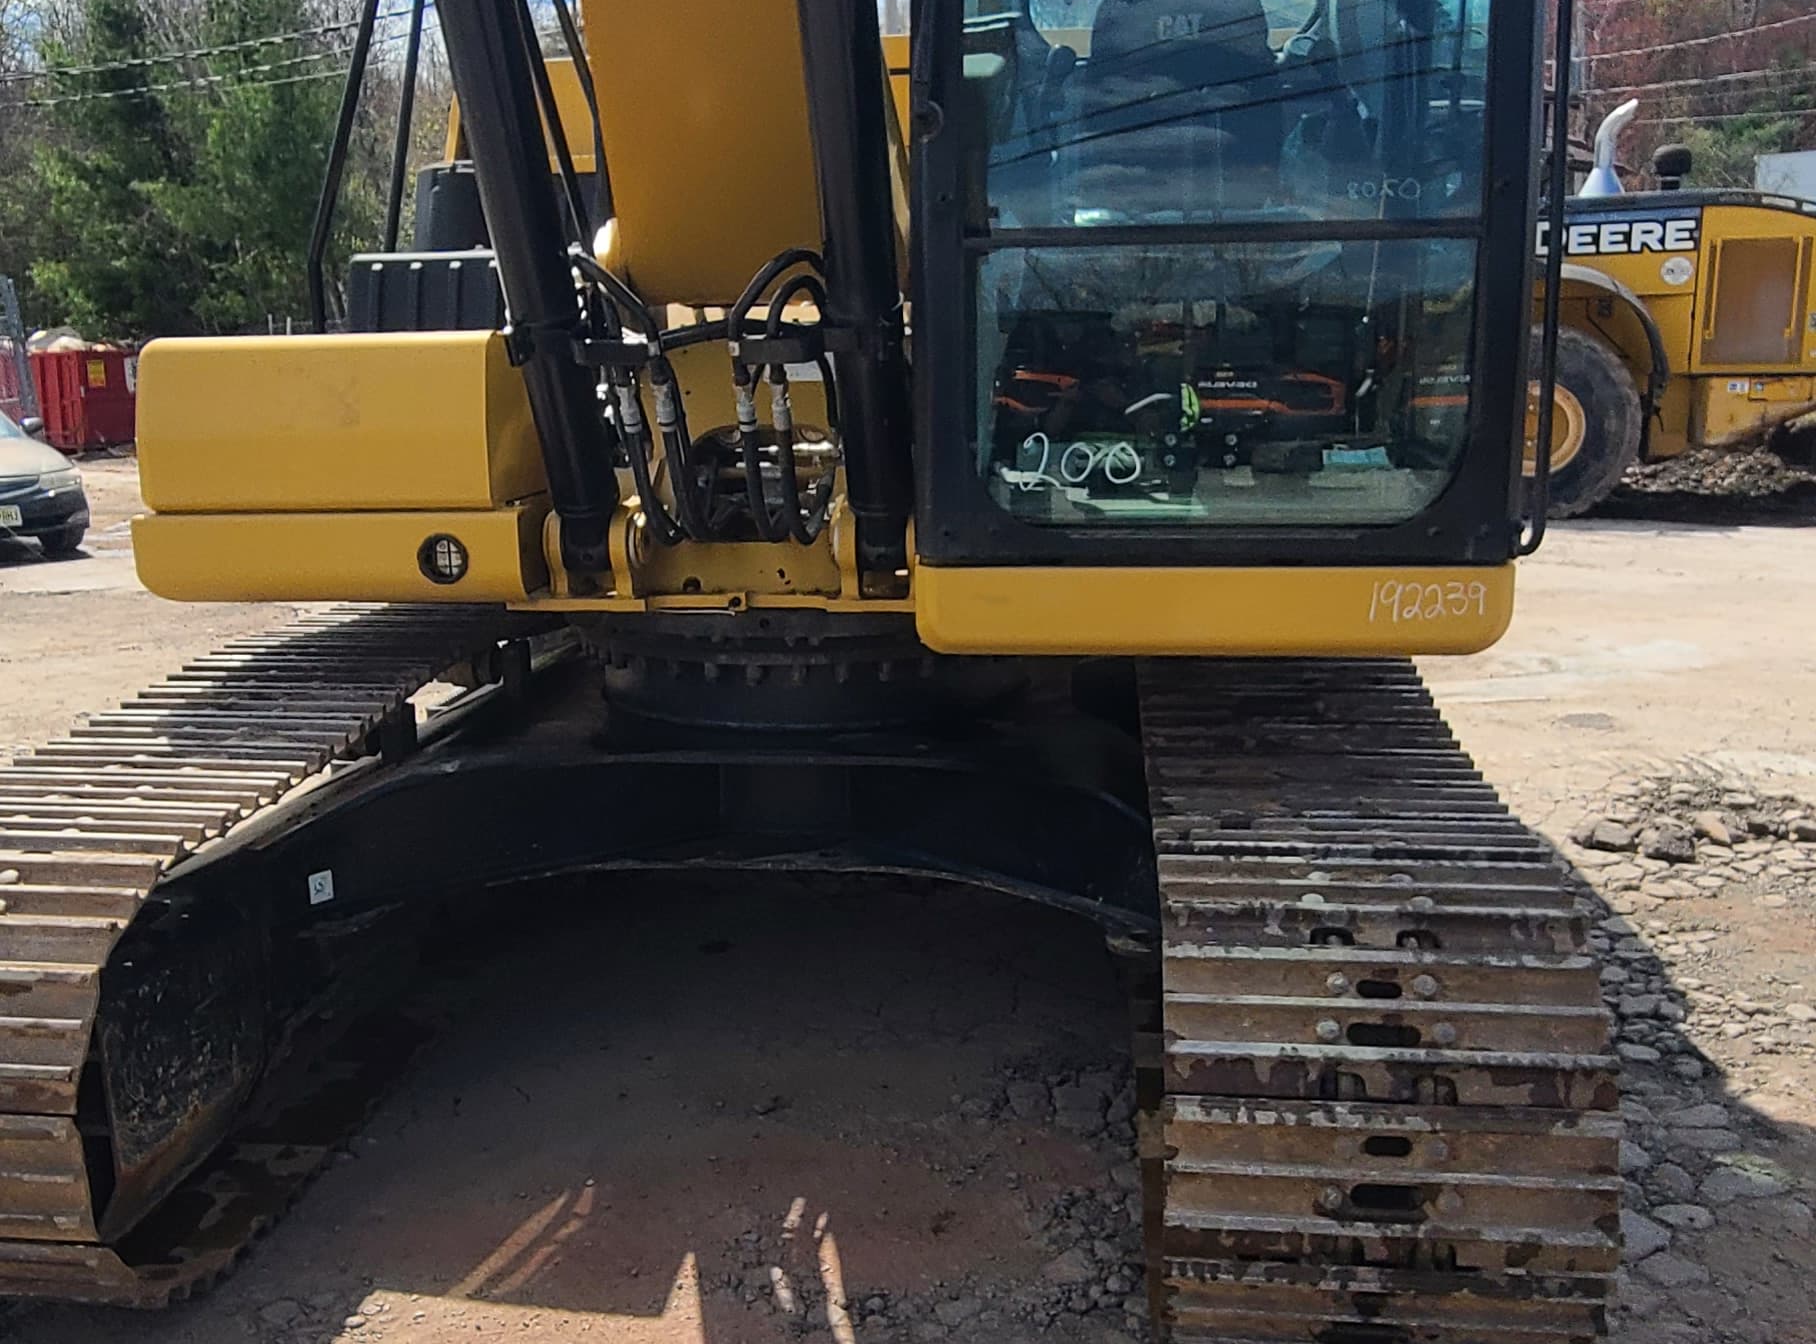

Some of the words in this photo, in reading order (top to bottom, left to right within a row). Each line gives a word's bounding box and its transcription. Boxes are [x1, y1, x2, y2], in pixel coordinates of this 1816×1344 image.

[1158, 14, 1202, 40] CAT
[1535, 219, 1697, 256] DEERE
[1369, 579, 1488, 624] 192239
